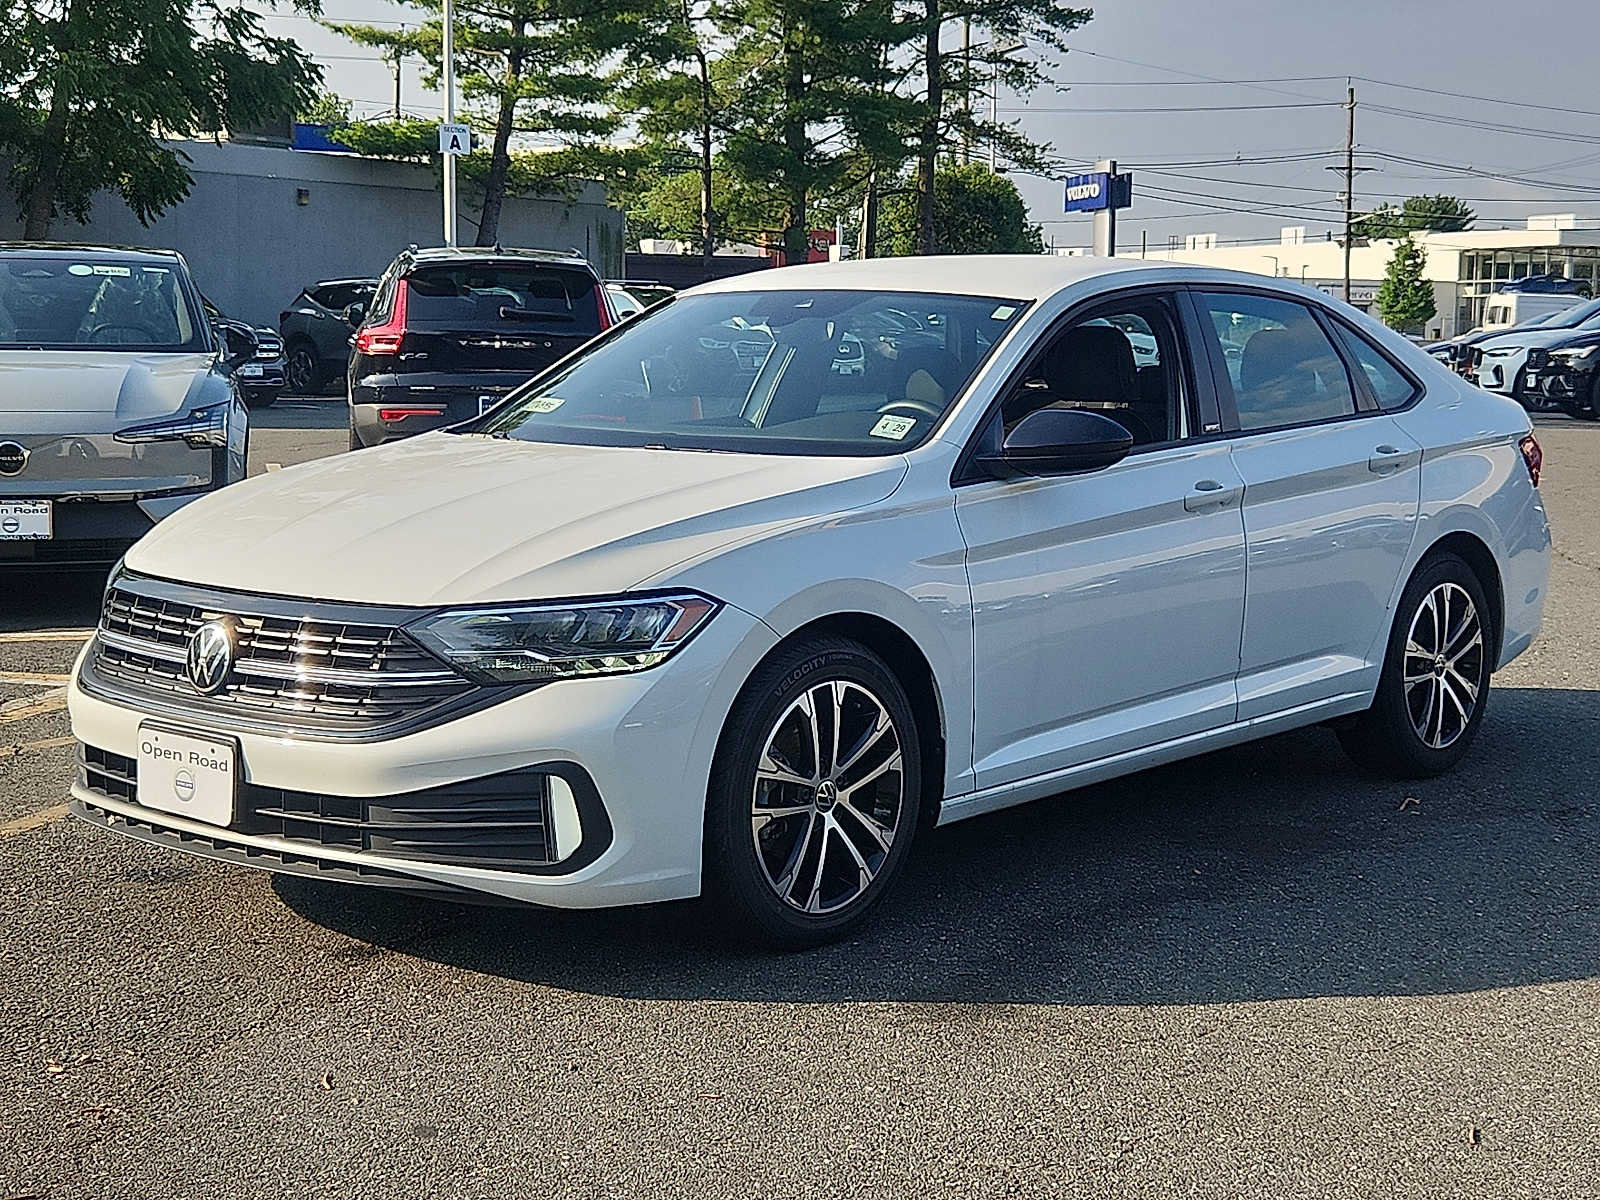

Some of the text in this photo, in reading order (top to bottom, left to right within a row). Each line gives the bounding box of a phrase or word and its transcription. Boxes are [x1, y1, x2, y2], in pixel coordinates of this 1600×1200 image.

[449, 134, 462, 150] A
[1066, 183, 1100, 201] VOLVO
[13, 506, 48, 514] Road
[774, 655, 826, 698] VELOCITY
[141, 741, 228, 772] Open Road
